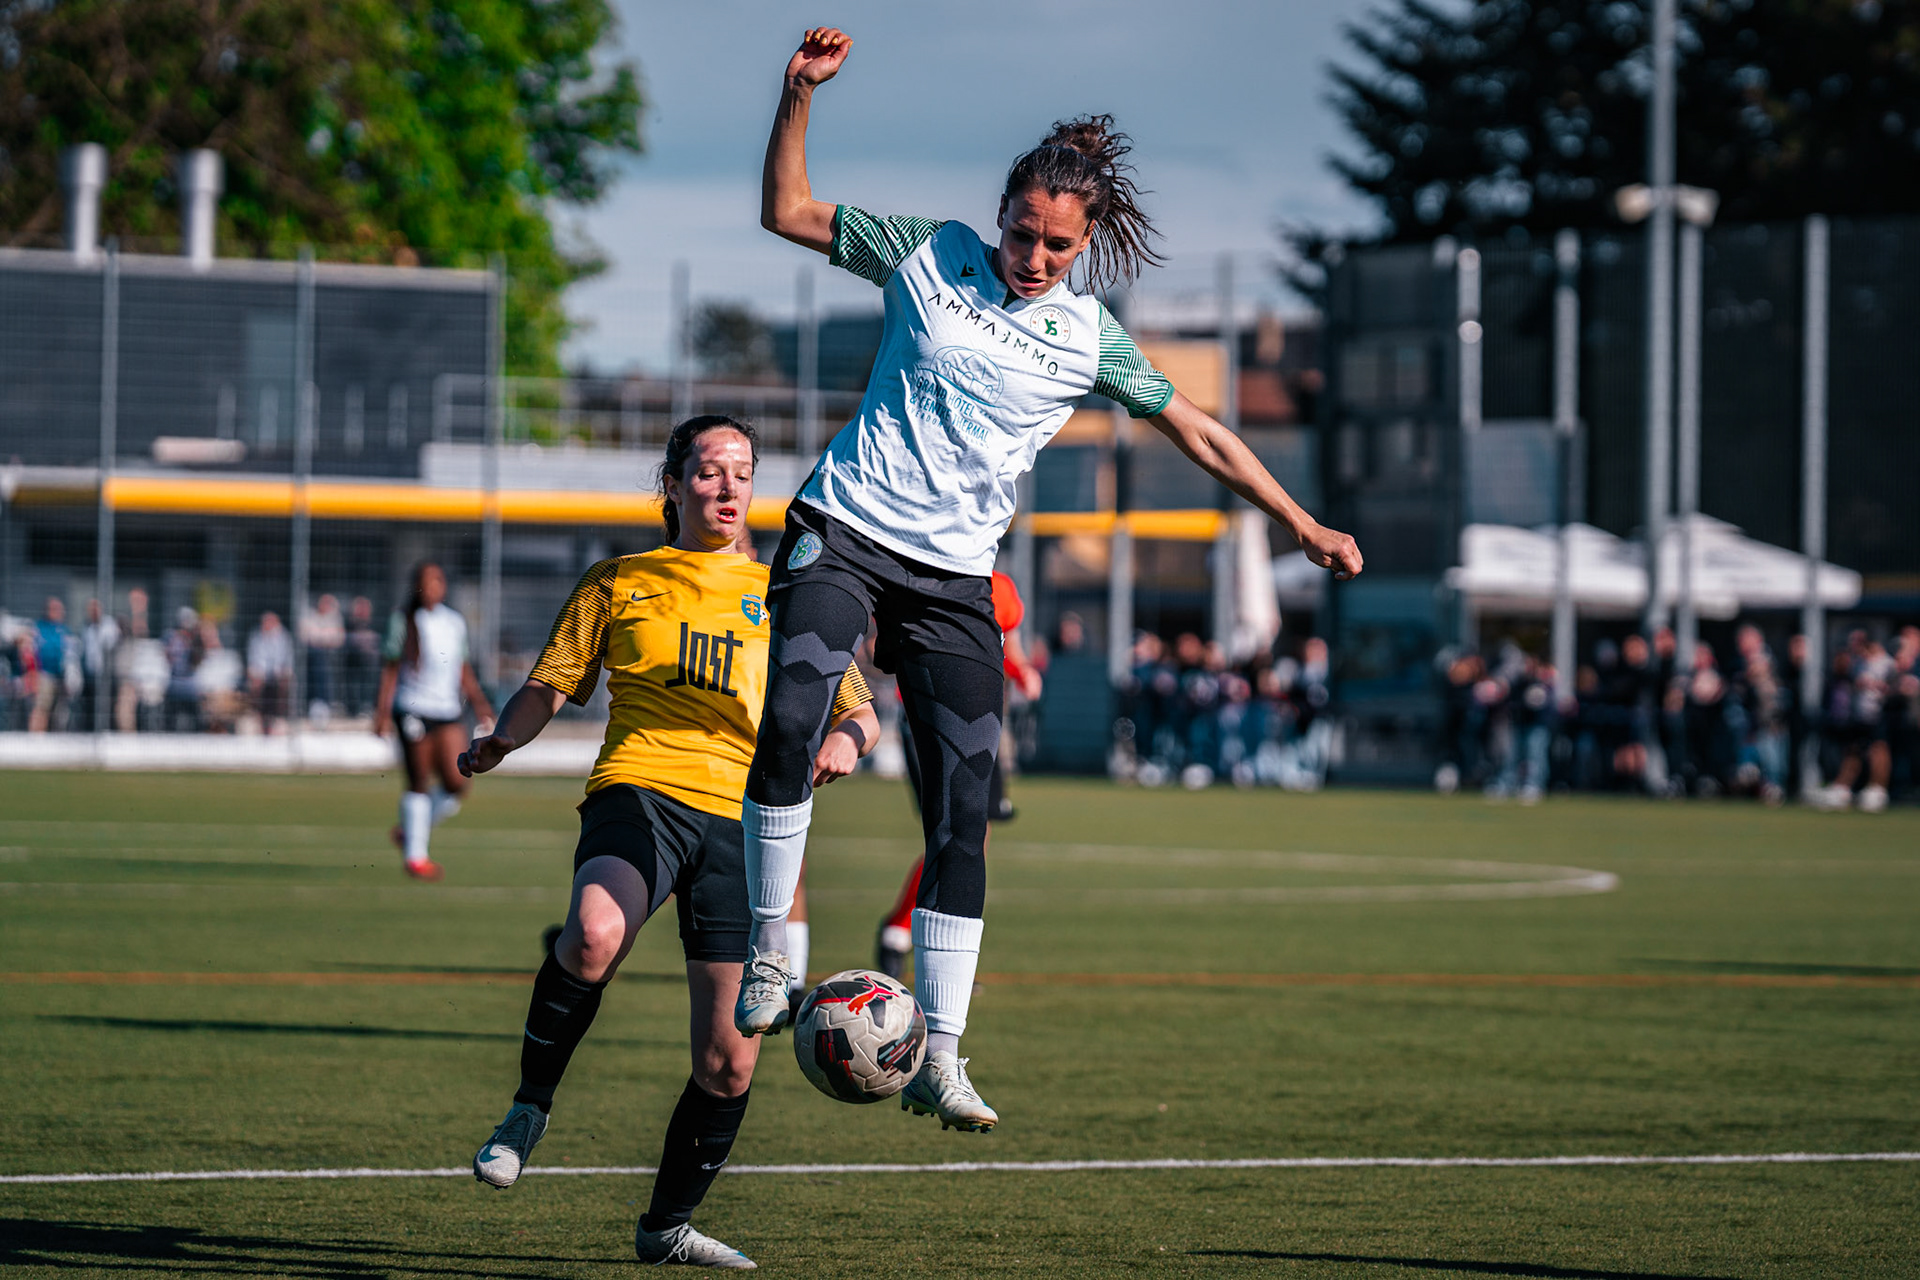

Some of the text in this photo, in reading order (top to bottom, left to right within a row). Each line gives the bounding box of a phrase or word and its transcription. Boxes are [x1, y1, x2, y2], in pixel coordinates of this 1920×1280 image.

[909, 392, 989, 443] & CENTRE THERMAL
[916, 376, 976, 418] GRAND HÔTEL
